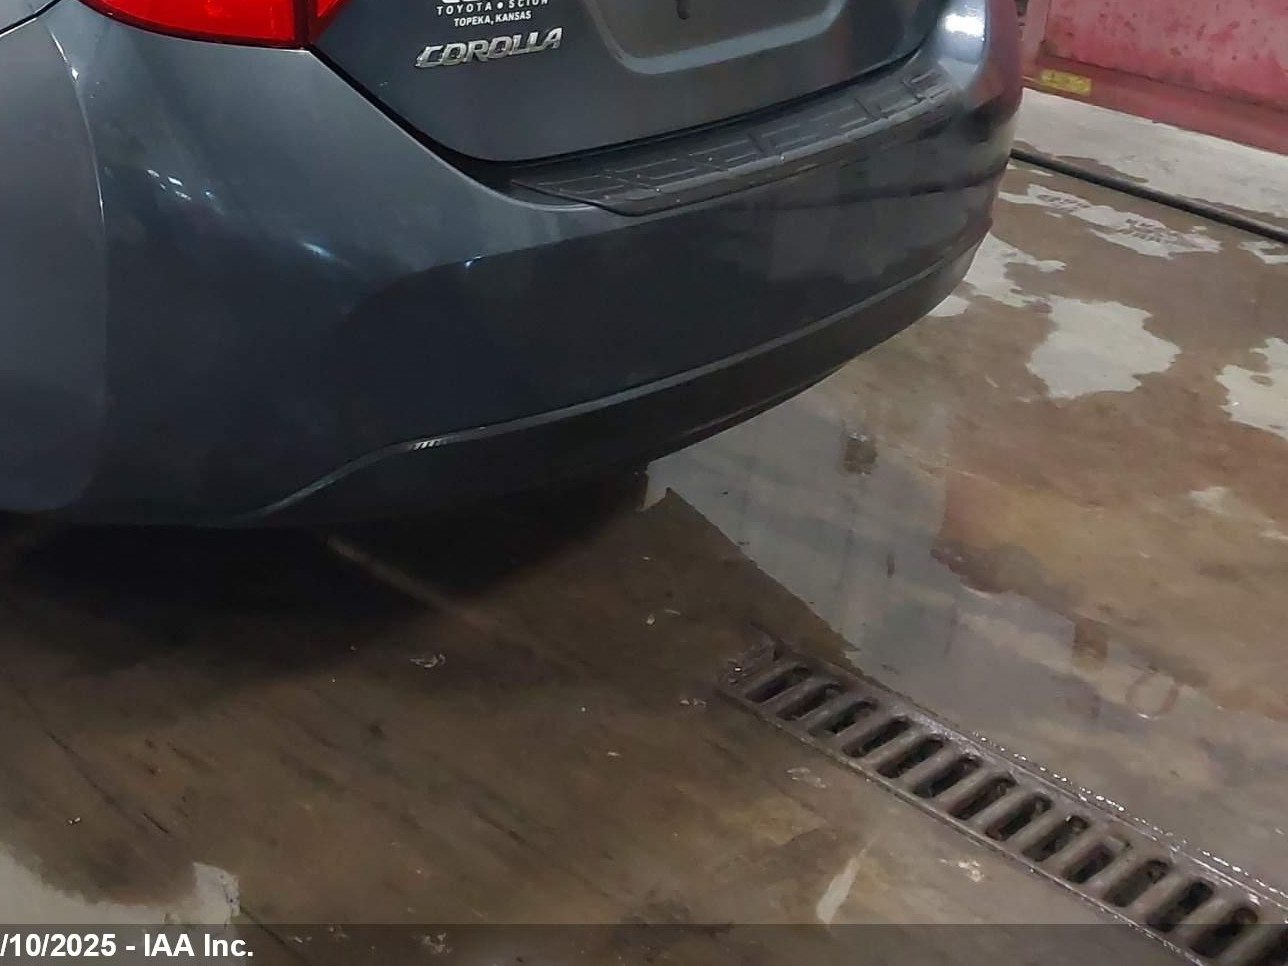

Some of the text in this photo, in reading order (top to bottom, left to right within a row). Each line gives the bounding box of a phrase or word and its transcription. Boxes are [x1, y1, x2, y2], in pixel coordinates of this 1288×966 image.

[436, 2, 493, 16] TOYOTA
[453, 10, 532, 27] TOPEKA, KANSAS
[415, 27, 563, 68] COROLLA
